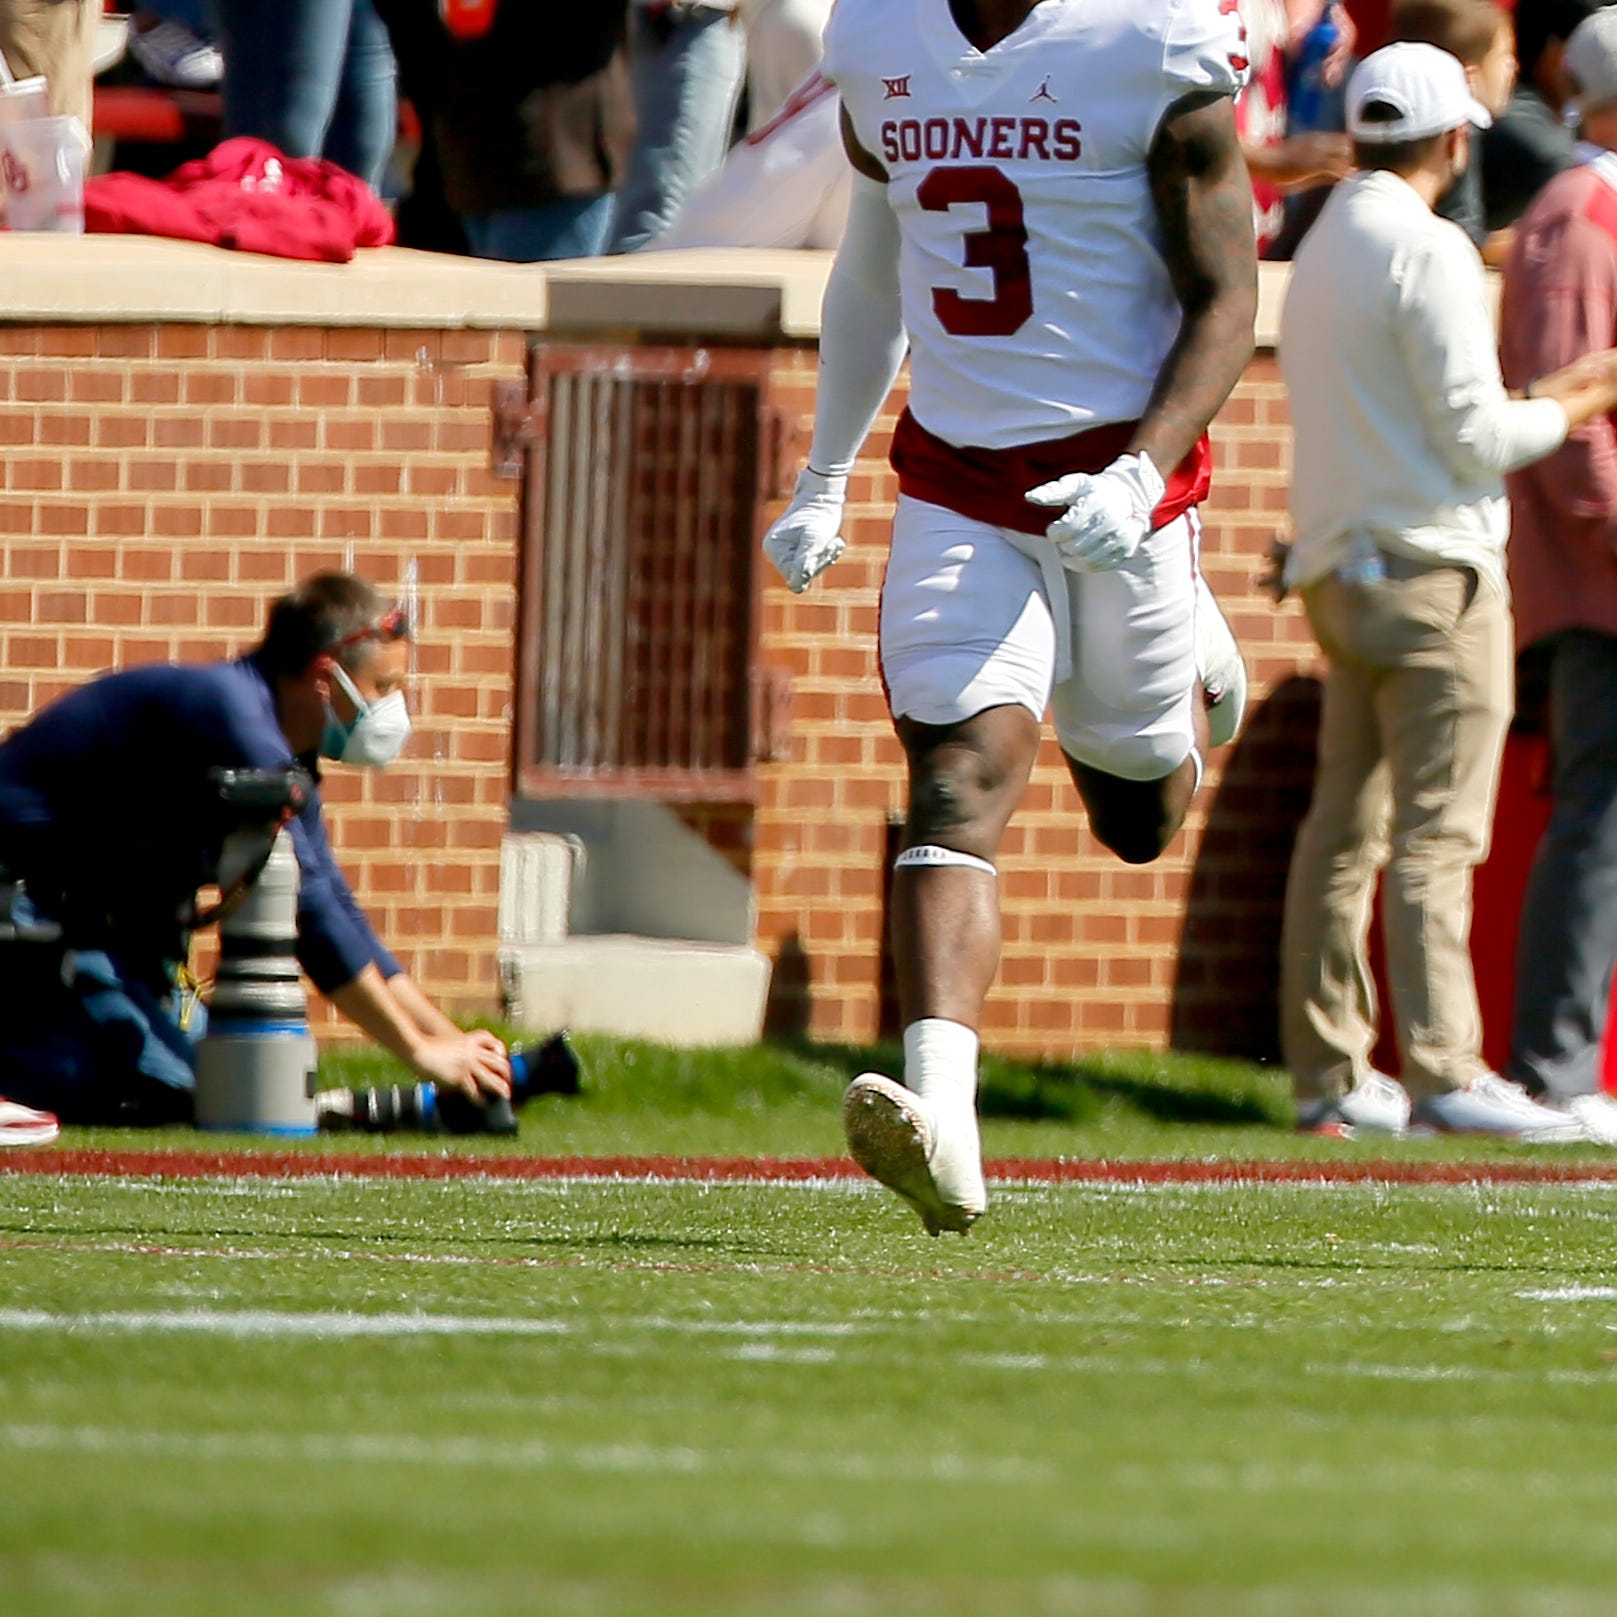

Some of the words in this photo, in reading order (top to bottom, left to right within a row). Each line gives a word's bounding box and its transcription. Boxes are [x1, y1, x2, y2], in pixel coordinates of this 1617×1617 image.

[881, 74, 911, 100] XII
[881, 116, 1082, 162] SOONERS
[916, 165, 1034, 337] 3
